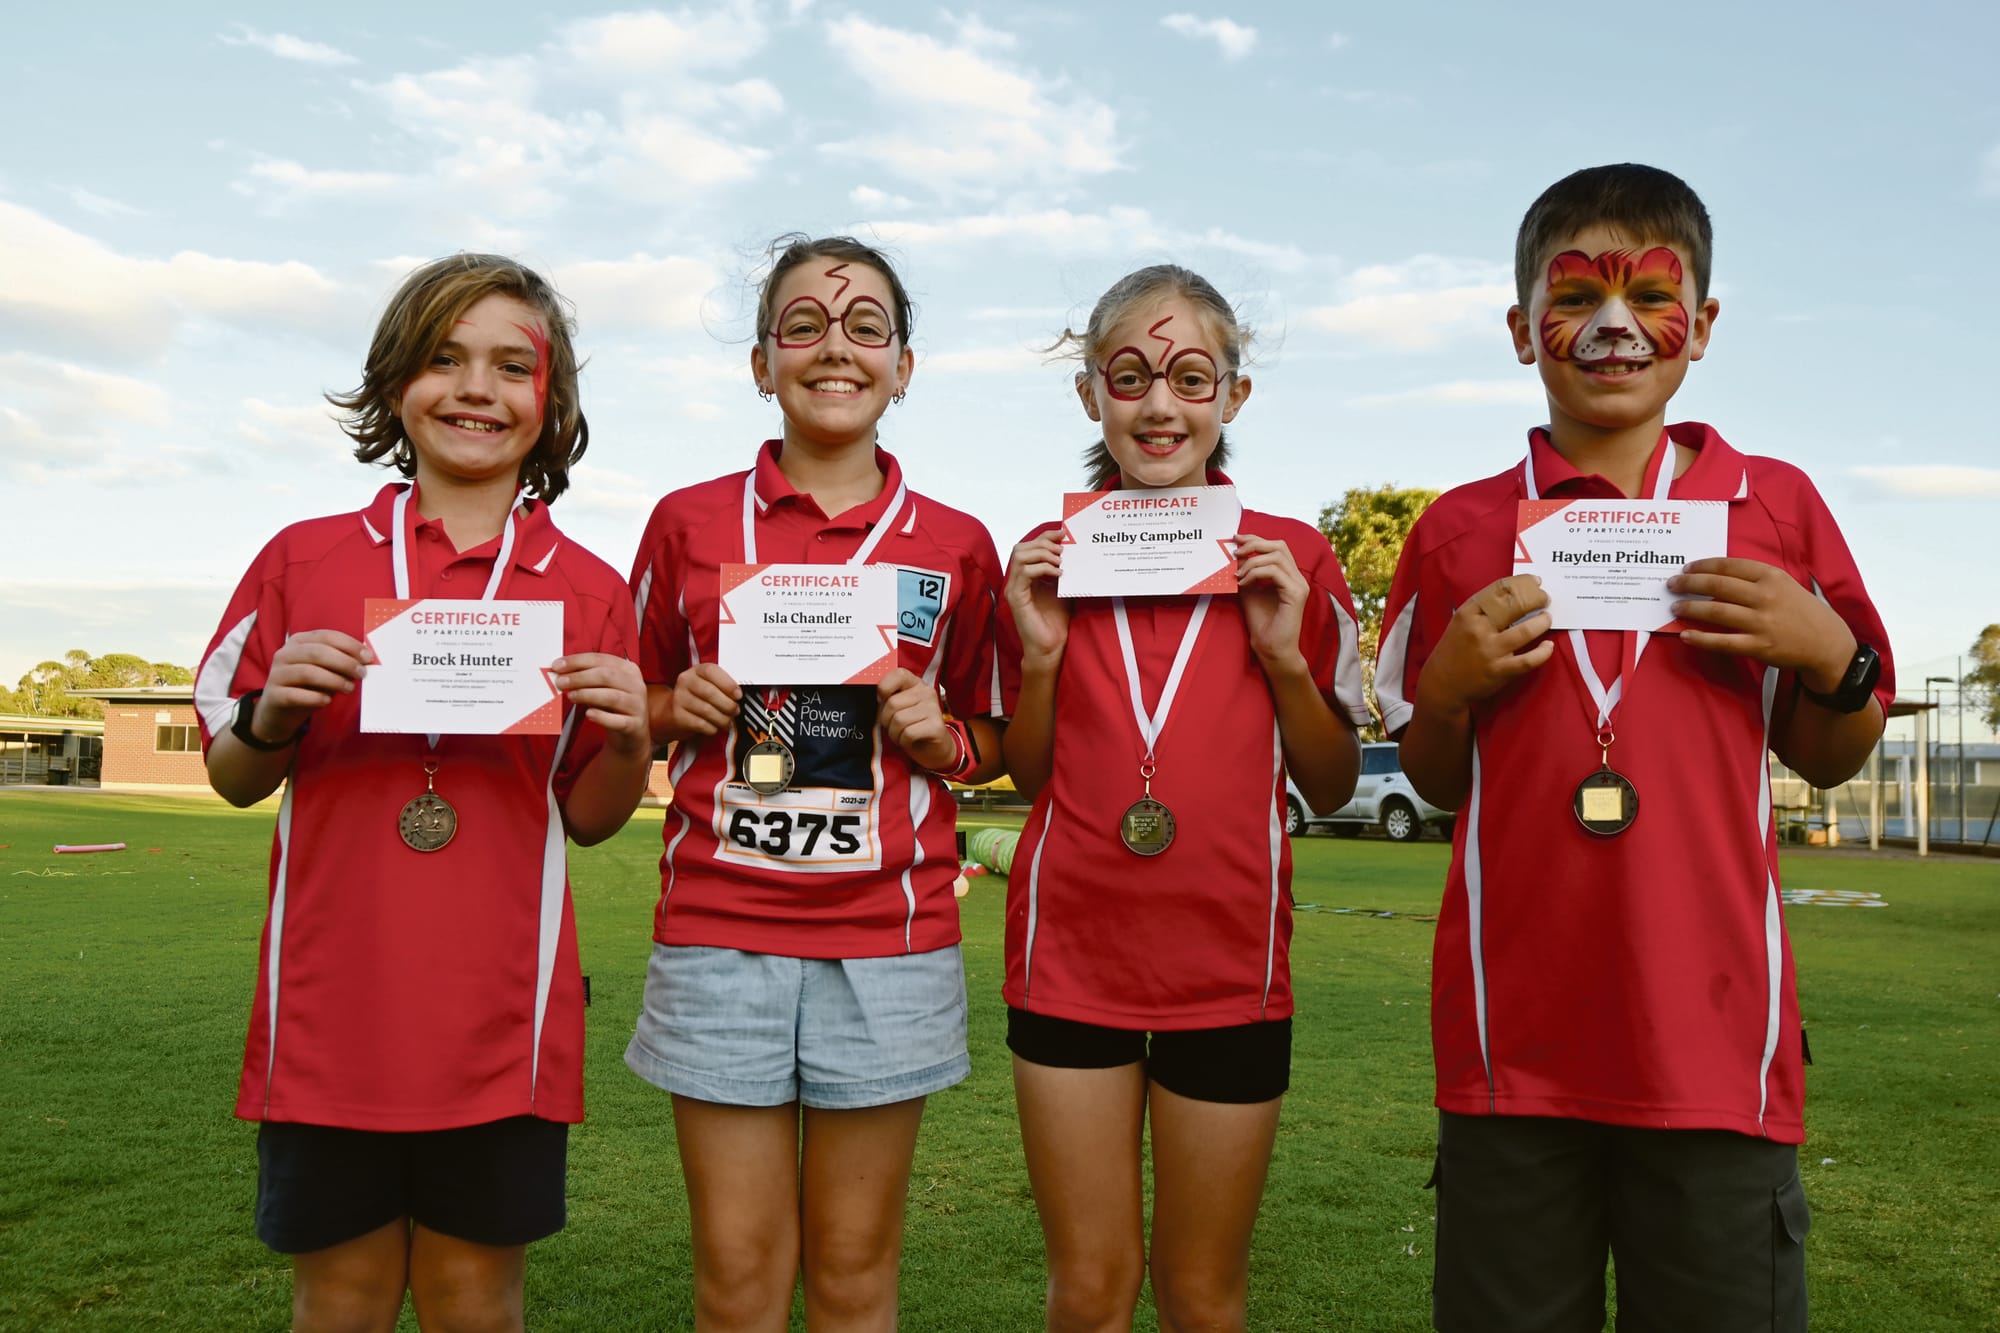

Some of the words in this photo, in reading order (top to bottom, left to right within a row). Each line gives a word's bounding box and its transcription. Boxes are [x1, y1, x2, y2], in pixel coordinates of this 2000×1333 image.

[1101, 496, 1198, 511] CERTIFICATE
[1121, 511, 1192, 519] PARTICIPATION
[1564, 510, 1681, 525] CERTIFICATE
[1091, 531, 1137, 545] Shelby
[1139, 529, 1203, 545] Campbell
[1586, 527, 1672, 535] PARTICIPATION
[1551, 549, 1612, 566] Hayden
[1615, 550, 1686, 566] Pridham
[761, 575, 859, 588] CERTIFICATE
[919, 578, 939, 600] 12
[411, 611, 521, 626] CERTIFICATE
[763, 611, 788, 624] Isla
[790, 611, 853, 624] Chandler
[434, 629, 513, 637] PARTICIPATION
[412, 652, 456, 666] Brock
[460, 654, 513, 667] Hunter
[801, 690, 822, 705] SA
[800, 705, 847, 722] Power
[799, 721, 864, 740] Networks
[729, 809, 861, 857] 6375
